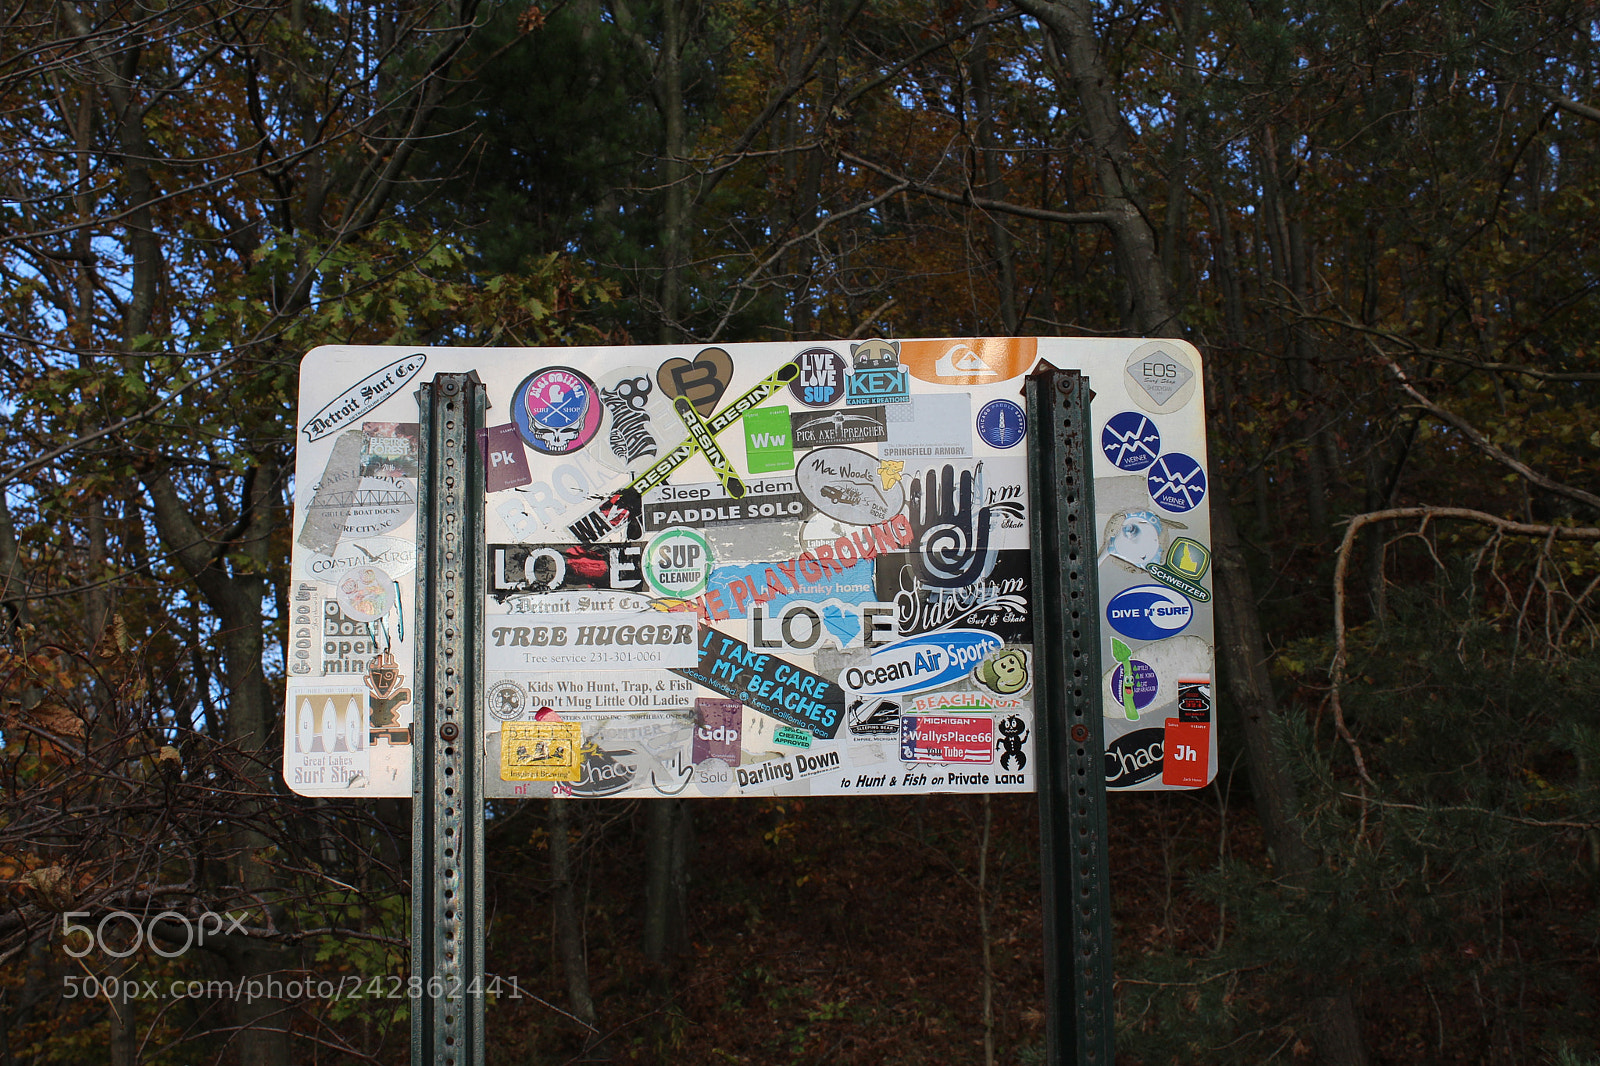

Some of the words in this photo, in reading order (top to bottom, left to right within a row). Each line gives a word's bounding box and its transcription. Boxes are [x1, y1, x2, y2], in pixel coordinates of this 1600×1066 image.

[1143, 362, 1177, 378] EOS
[310, 397, 361, 438] Detroit
[359, 372, 395, 406] Surf
[395, 362, 419, 378] Co.
[804, 386, 835, 402] SUP
[871, 396, 909, 404] KREATIONS
[711, 384, 771, 431] RESIN
[370, 437, 410, 446] ELECTRIC
[683, 409, 726, 469] RESIN
[751, 432, 786, 448] Ww
[796, 430, 816, 442] PICK
[819, 429, 835, 440] AXE
[843, 425, 885, 438] PREACHER
[369, 445, 410, 456] FOREST
[490, 450, 516, 467] Pk
[884, 447, 932, 456] SPRINGFIELD
[1123, 454, 1147, 464] WERNER
[633, 447, 691, 494] RESIN
[812, 459, 838, 476] Mac
[661, 487, 710, 500] Sleep
[717, 480, 793, 496] Tndem
[871, 503, 888, 513] DUNE
[1162, 495, 1186, 506] WERNER
[653, 505, 741, 525] PADDLE
[747, 501, 803, 518] SOLO
[379, 519, 393, 528] NC
[658, 544, 700, 569] SUP
[728, 514, 914, 616] PLAYGROUND
[659, 572, 701, 584] CLEANUP
[1150, 565, 1207, 600] SCHWEITZER
[799, 583, 832, 595] funky
[835, 583, 871, 593] home
[515, 596, 572, 614] Detroit
[577, 596, 615, 612] Surf
[618, 596, 645, 611] Co.
[1111, 609, 1140, 619] DIVE
[1156, 606, 1190, 617] SURF
[295, 605, 311, 625] DO
[966, 614, 989, 627] Surf
[1002, 611, 1026, 623] Skate
[491, 625, 568, 647] TREE
[574, 624, 694, 647] HUGGER
[292, 628, 312, 675] GOOD
[522, 652, 549, 664] Tree
[550, 652, 587, 664] service
[589, 651, 662, 663] 231-301-0061
[947, 638, 996, 670] Sports
[702, 631, 714, 648] I
[719, 638, 771, 673] TAKE
[774, 664, 830, 700] CARE
[527, 681, 554, 693] Kids
[557, 680, 584, 693] Who
[587, 680, 619, 693] Hunt,
[621, 680, 653, 695] Trap,
[655, 680, 666, 691] &
[669, 679, 693, 692] Fish
[708, 677, 737, 696] Minded
[711, 658, 744, 684] MY
[747, 674, 837, 728] BEACHES
[531, 695, 563, 707] Don't
[566, 695, 593, 710] Mug
[595, 694, 626, 706] Little
[628, 694, 649, 706] Old
[652, 693, 689, 706] Ladies
[915, 693, 976, 712] BEACH
[751, 698, 771, 712] Keep
[772, 707, 806, 730] California
[807, 723, 829, 738] Clean
[698, 724, 738, 745] Gdp
[775, 737, 810, 748] APPROVED
[779, 731, 808, 741] CHEETAH
[909, 730, 992, 744] WallysPlace66
[926, 746, 942, 757] You
[944, 746, 964, 758] Tube
[1174, 744, 1197, 762] Jh
[303, 756, 326, 767] Great
[328, 755, 353, 766] Lakes
[736, 761, 794, 788] Darling
[795, 750, 840, 774] Down
[1105, 740, 1164, 782] Chac
[295, 766, 326, 784] Surf
[700, 771, 728, 783] Sold
[840, 777, 851, 788] to
[856, 774, 886, 788] Hunt
[889, 777, 897, 787] &
[902, 773, 927, 787] Fish
[931, 777, 945, 785] on
[948, 772, 990, 785] Private
